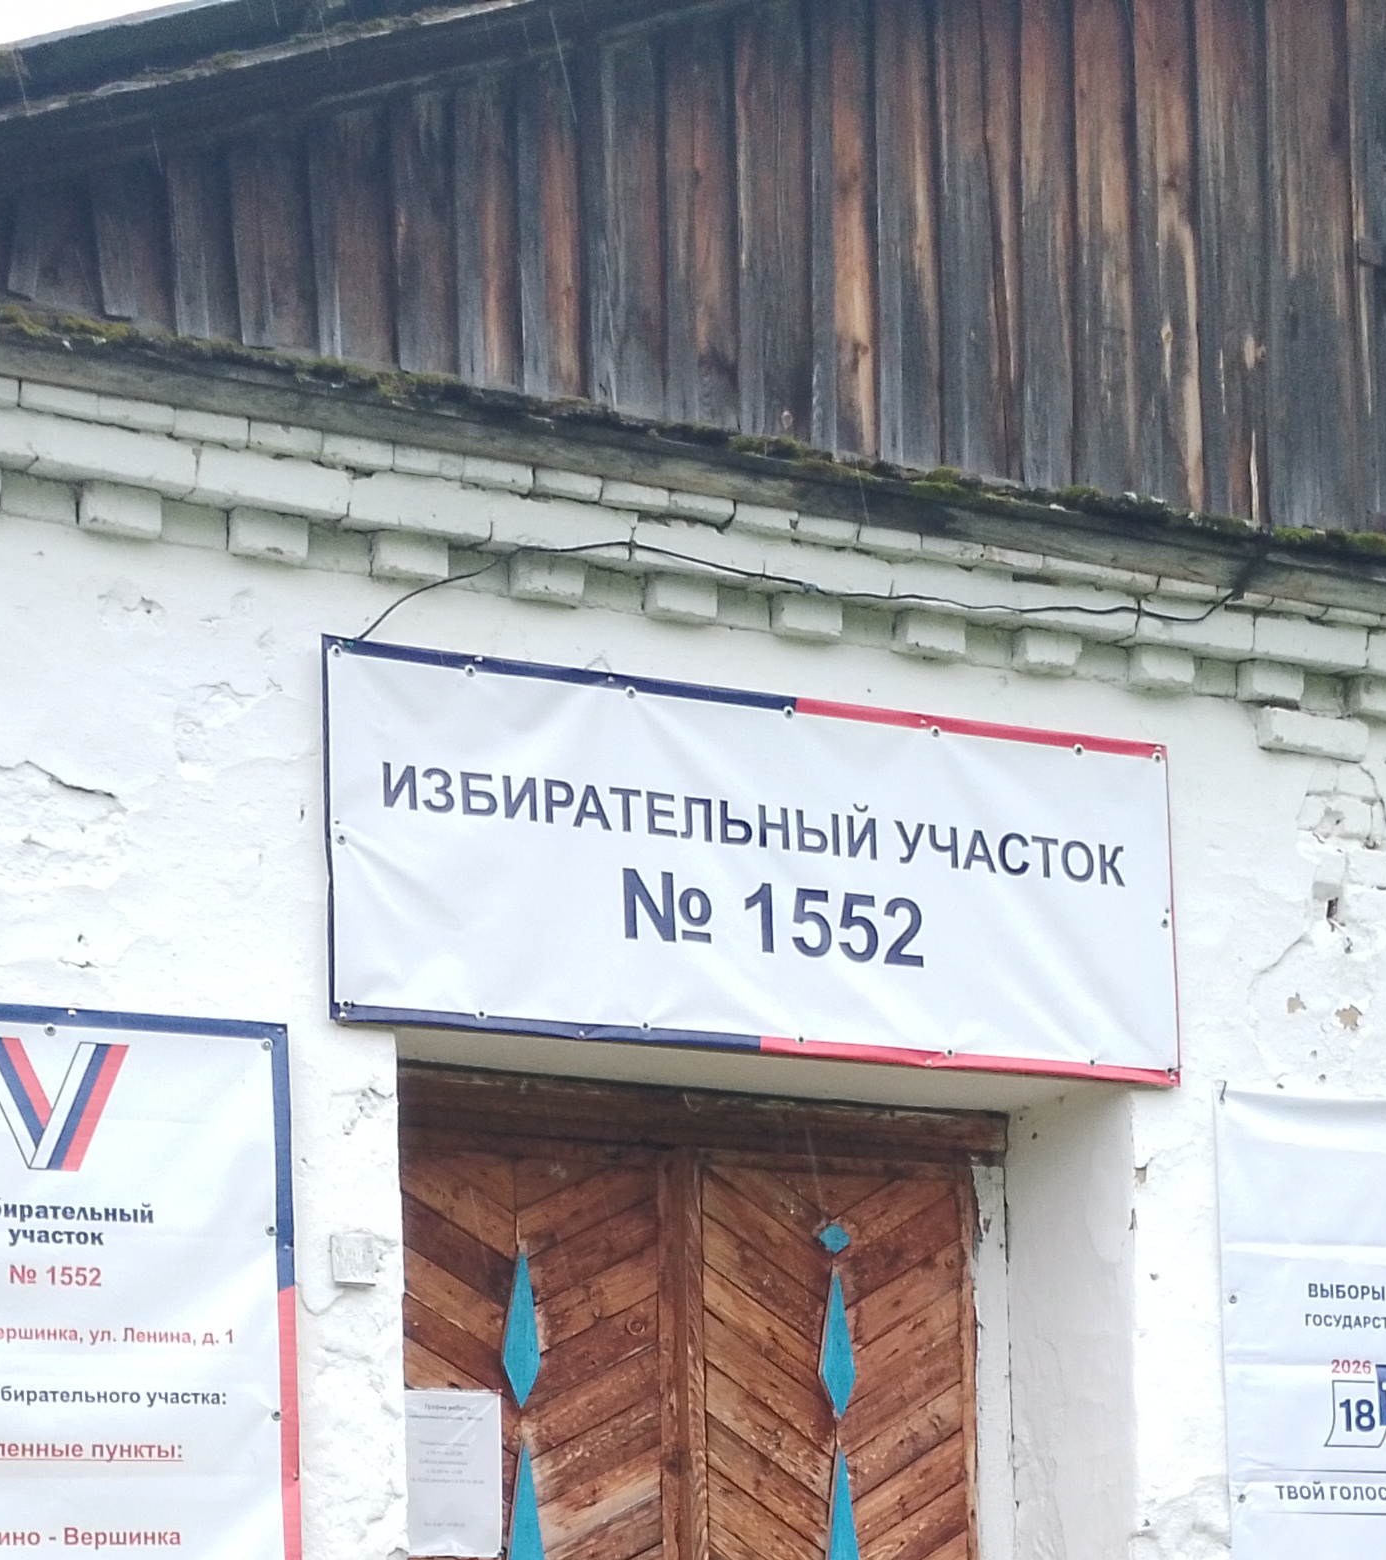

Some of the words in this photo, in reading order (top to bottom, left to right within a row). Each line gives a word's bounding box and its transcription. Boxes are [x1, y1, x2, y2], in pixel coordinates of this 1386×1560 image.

[382, 761, 877, 861] ИЗБИРАТЕЛЬНЫЙ
[894, 820, 1125, 887] УЧАСТОК
[622, 867, 712, 944] №
[744, 882, 924, 968] 1552
[8, 1228, 104, 1247] участок
[10, 1264, 37, 1284] №
[47, 1266, 101, 1287] 1552
[1308, 1283, 1385, 1301] ВЫБОРЫ
[89, 1330, 116, 1345] ул.
[123, 1327, 196, 1345] Ленина,
[202, 1333, 219, 1345] д.
[226, 1329, 232, 1343] 1
[1331, 1359, 1371, 1374] 2026
[146, 1392, 226, 1408] участка:
[1339, 1399, 1375, 1432] 18
[91, 1444, 183, 1462] пункты:
[1275, 1480, 1325, 1500] ТВОЙ
[64, 1527, 181, 1550] Вершинка
